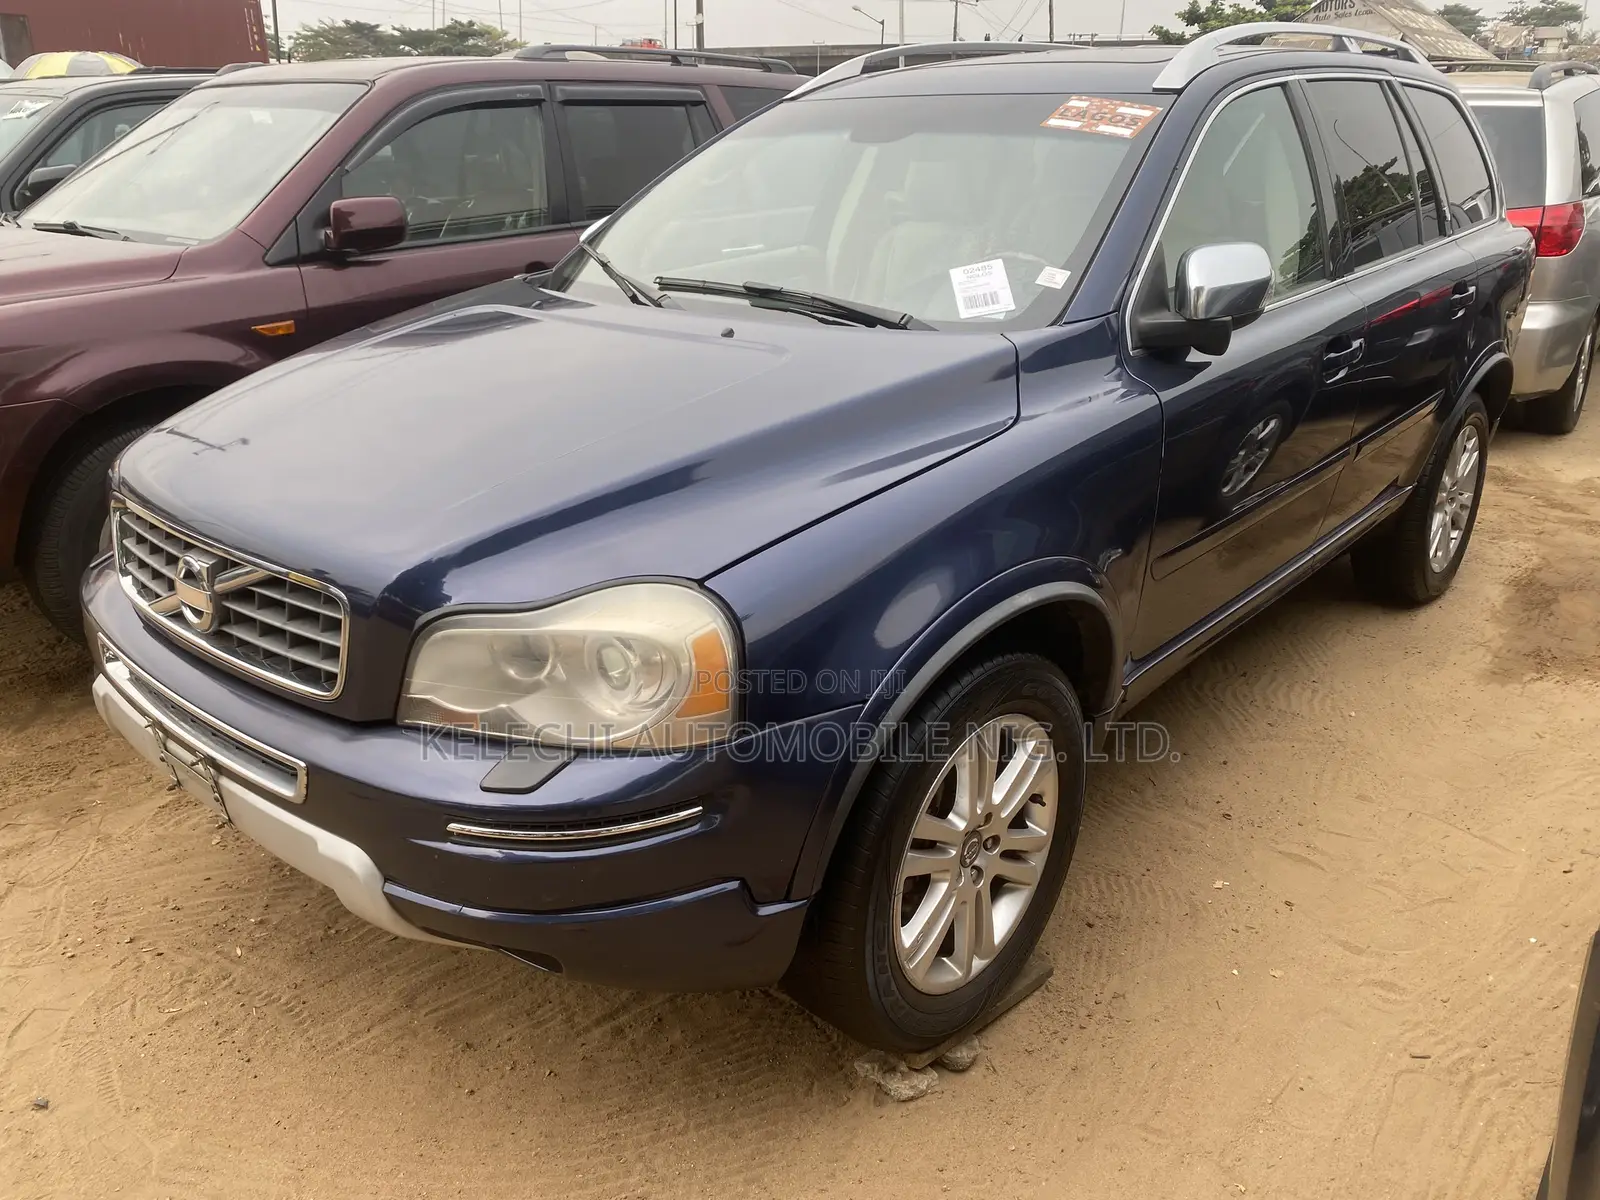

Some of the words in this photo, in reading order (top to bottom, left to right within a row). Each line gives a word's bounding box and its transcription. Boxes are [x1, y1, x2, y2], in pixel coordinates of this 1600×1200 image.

[1334, 10, 1353, 19] Sales
[1058, 107, 1142, 127] LAGOS
[963, 263, 993, 275] 02485
